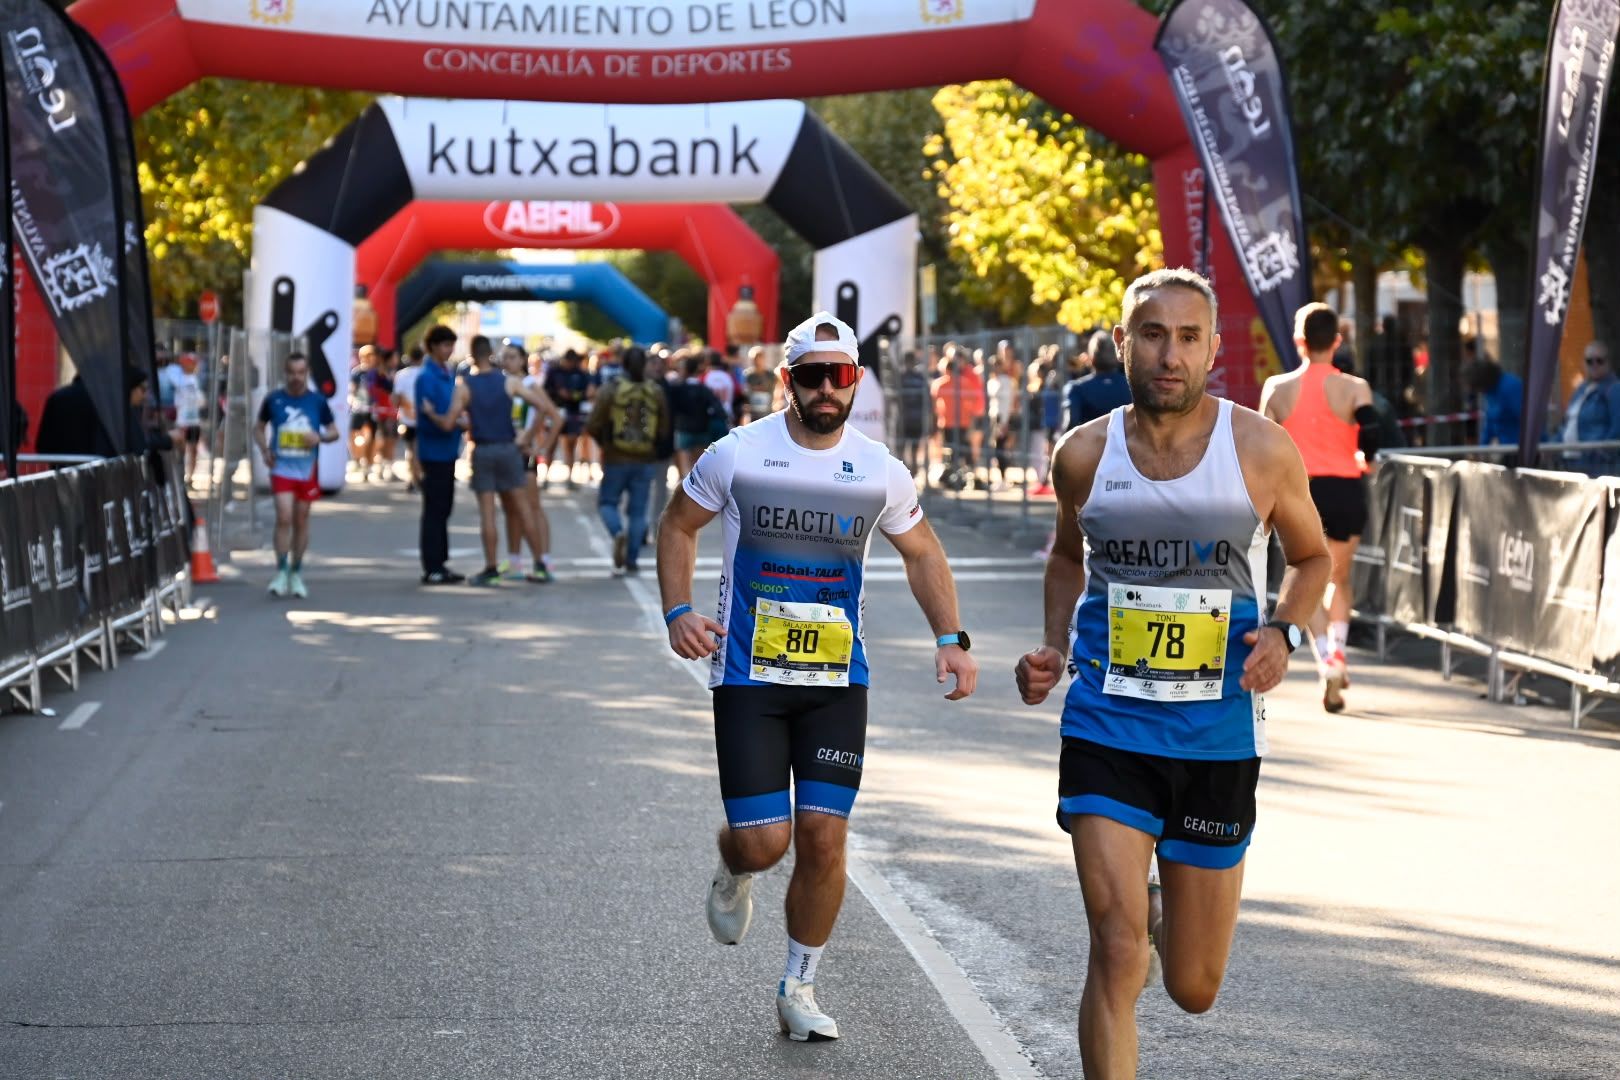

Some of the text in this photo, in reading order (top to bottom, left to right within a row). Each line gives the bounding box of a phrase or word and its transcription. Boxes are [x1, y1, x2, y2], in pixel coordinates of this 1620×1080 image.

[366, 0, 673, 36] AYUNTAMIENTO
[688, 2, 735, 34] DE
[422, 47, 792, 78] CONCEJALÍA DE DEPORTES
[427, 123, 761, 177] kutxabank
[502, 200, 604, 234] ABRIL
[757, 505, 865, 538] CEACTIVO
[795, 533, 834, 544] ESPECTRO
[1105, 539, 1231, 568] CEACTIVO
[1148, 568, 1192, 578] ESPECTRO
[1193, 568, 1228, 577] AUTISTA
[783, 621, 813, 630] SALAZAR
[1155, 614, 1177, 622] TONI
[786, 628, 819, 654] 80
[1147, 621, 1186, 659] 78
[816, 747, 864, 767] CEACTIV
[1184, 815, 1241, 836] CEACTIVO
